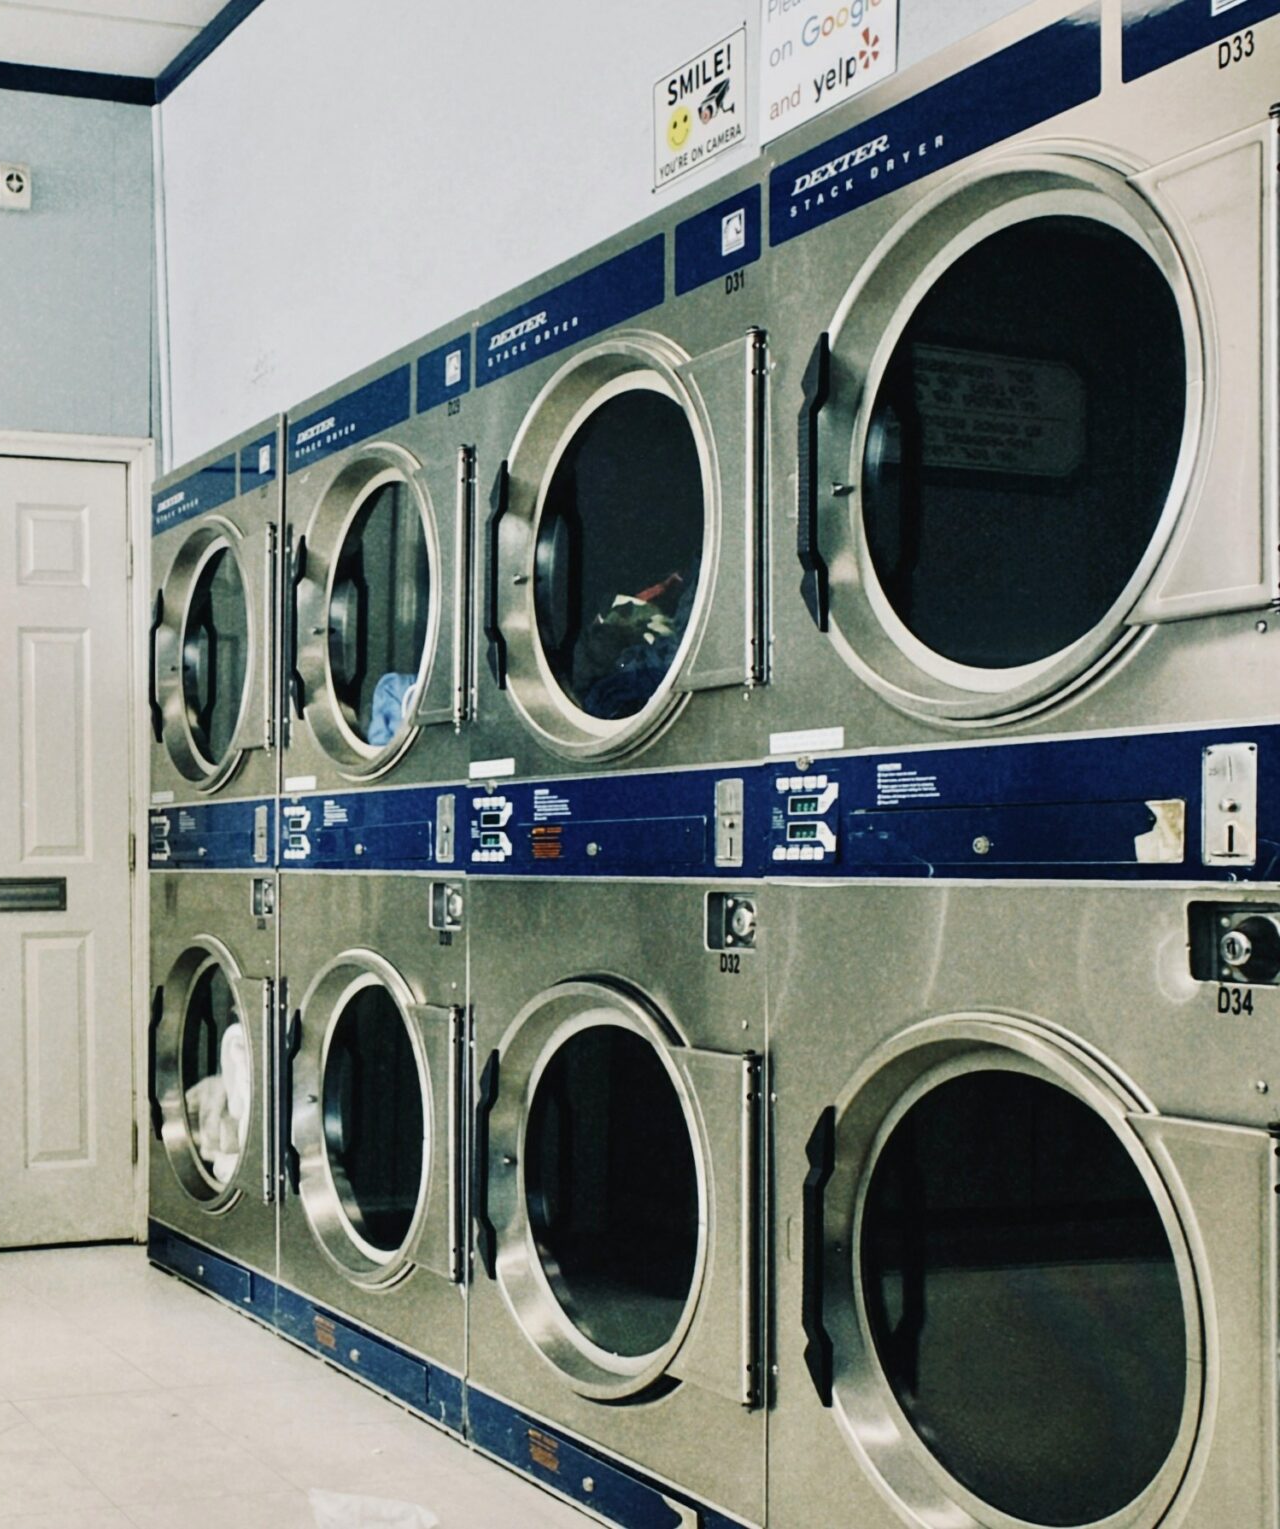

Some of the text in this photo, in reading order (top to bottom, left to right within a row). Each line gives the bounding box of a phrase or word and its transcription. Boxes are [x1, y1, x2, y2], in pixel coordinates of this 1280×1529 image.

[769, 0, 882, 67] on Goog
[1218, 30, 1255, 70] D33
[667, 43, 731, 106] SMILE!
[769, 56, 857, 120] and yelp
[659, 123, 742, 179] YOU'RE ON CAMERA
[790, 134, 889, 197] DEXTER
[790, 134, 944, 218] STACK DRYER
[726, 269, 744, 295] D31
[488, 311, 547, 351] DEXTER
[720, 953, 740, 974] D32
[1218, 987, 1253, 1016] D34
